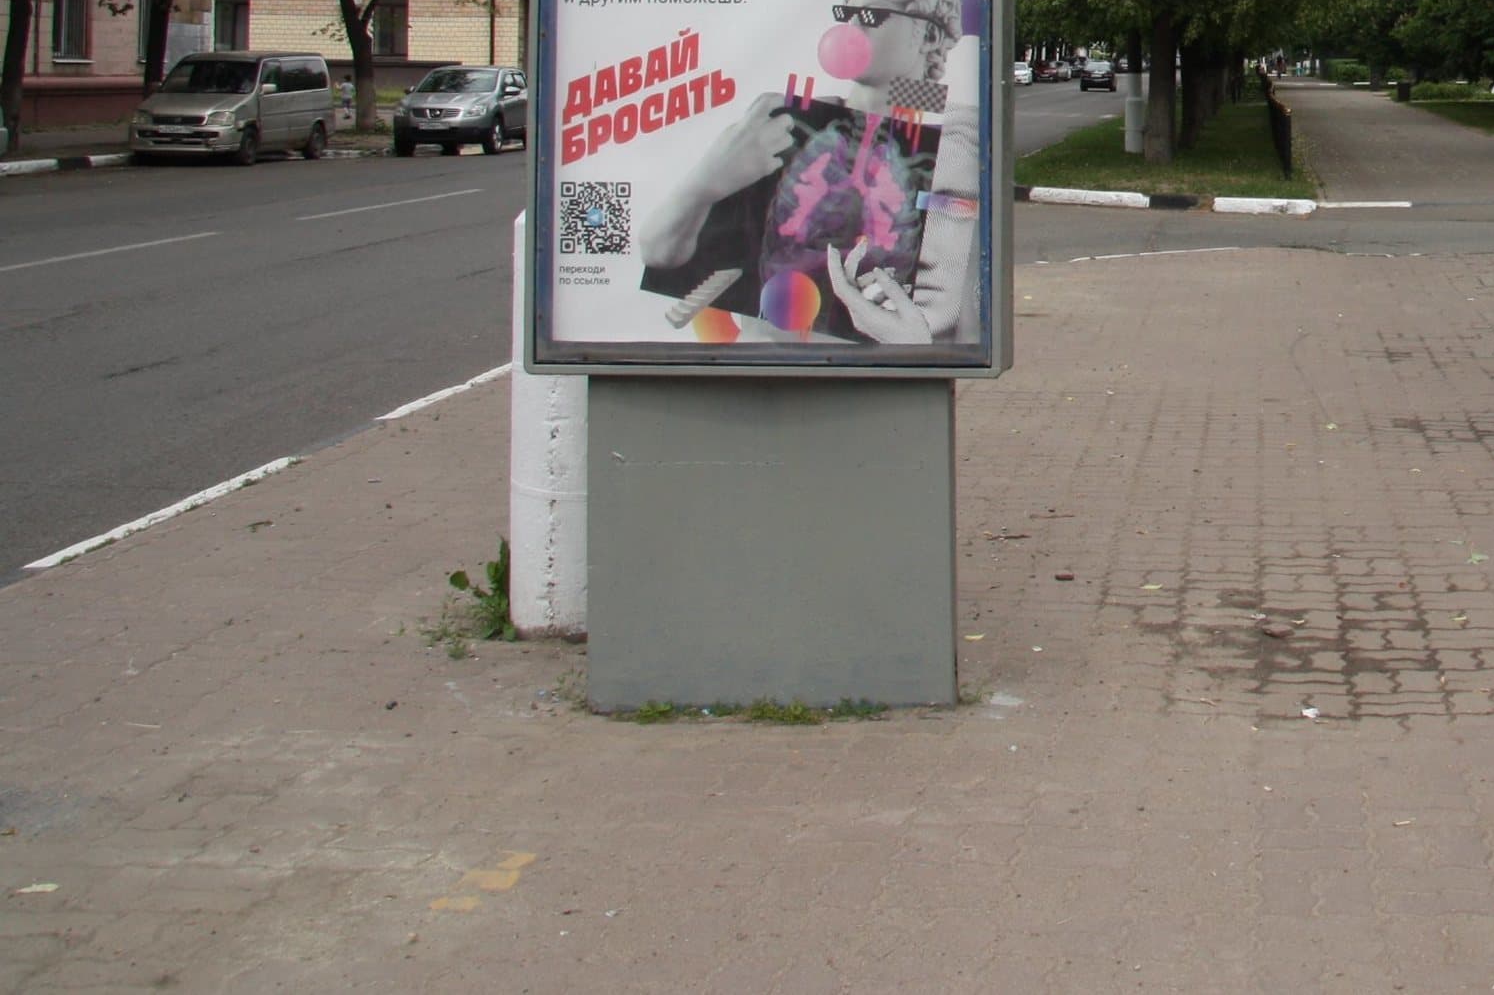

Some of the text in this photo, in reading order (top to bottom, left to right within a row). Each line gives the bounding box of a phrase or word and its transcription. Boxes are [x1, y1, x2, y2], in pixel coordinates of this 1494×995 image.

[561, 27, 700, 124] ДАВАЙ
[561, 69, 736, 166] БРОСАТЬ
[559, 265, 606, 275] переходи
[559, 277, 610, 285] по ссылке
